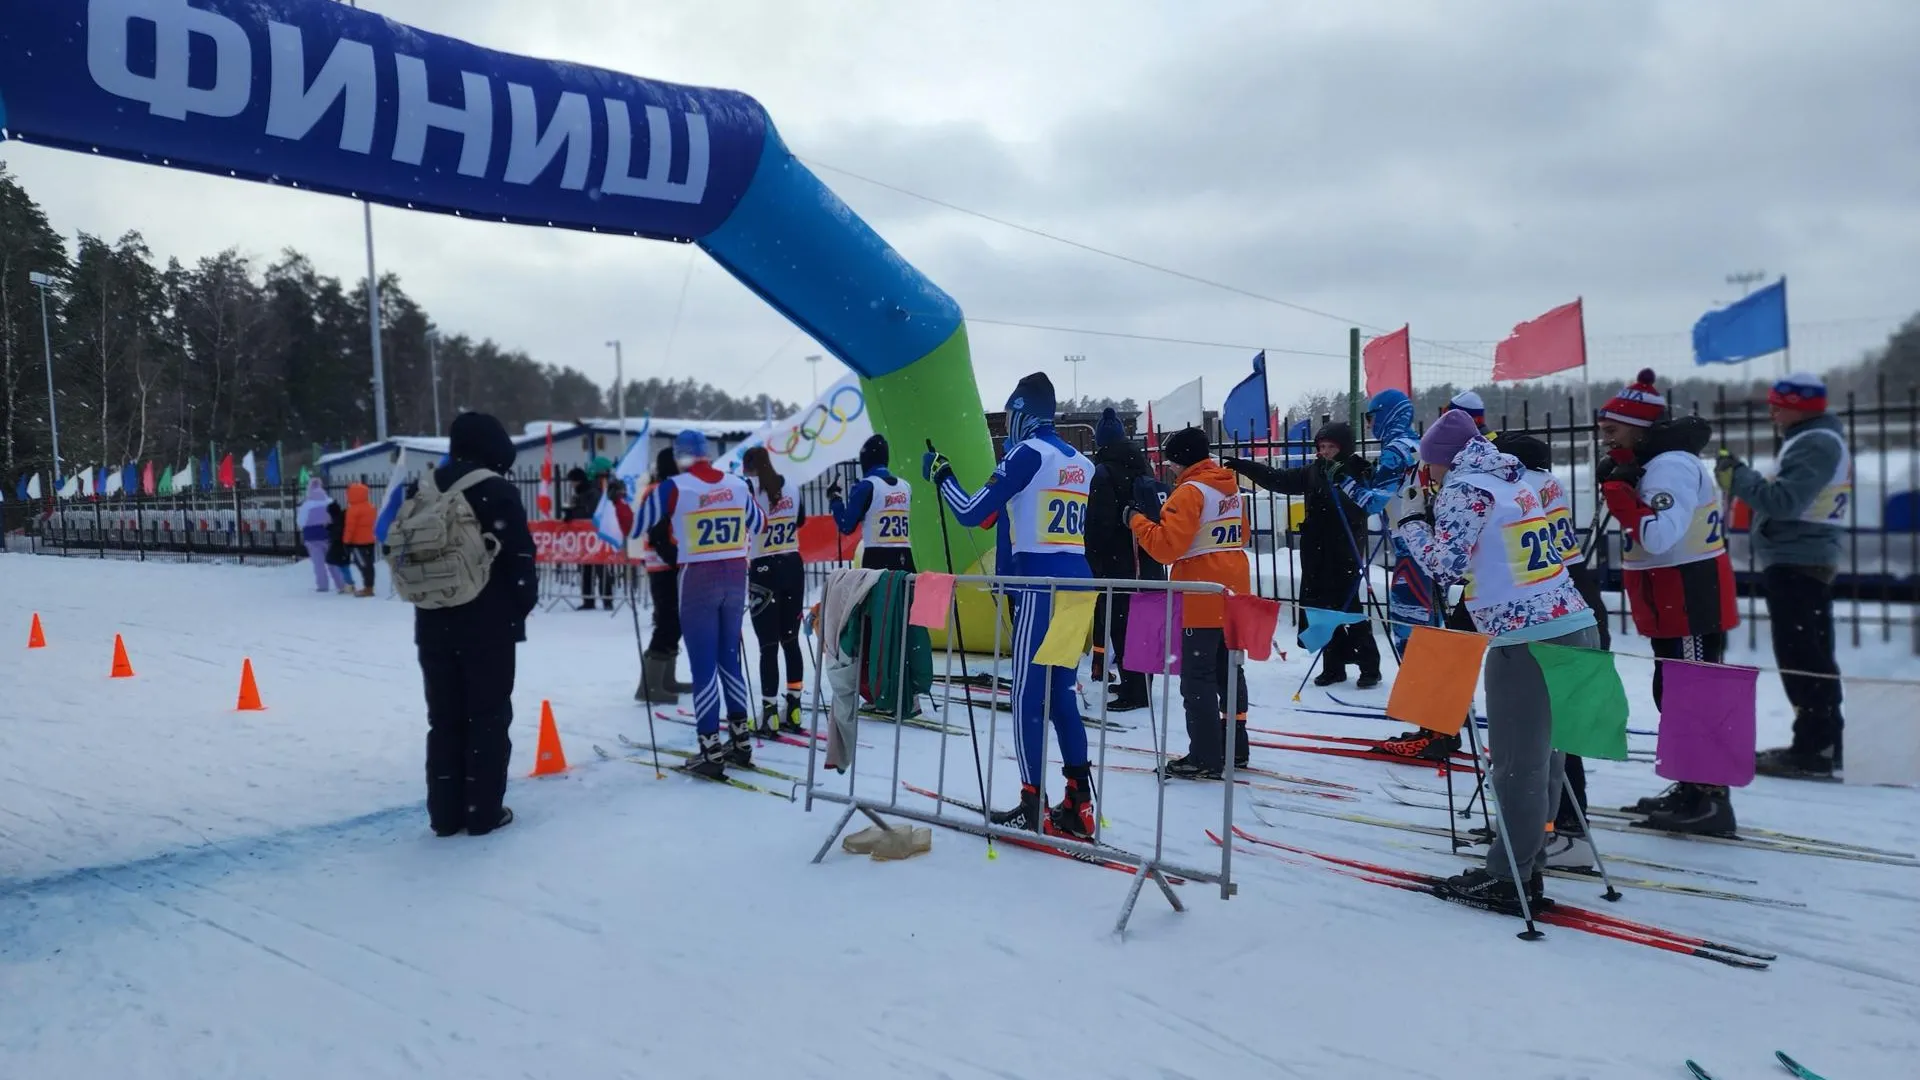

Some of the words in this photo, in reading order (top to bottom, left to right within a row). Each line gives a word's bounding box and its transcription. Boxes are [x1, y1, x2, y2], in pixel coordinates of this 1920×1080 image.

[87, 0, 711, 204] ФИНИШ
[697, 516, 741, 546] 257
[763, 521, 798, 548] 232
[879, 515, 909, 537] 235
[1211, 524, 1242, 545] 24
[532, 531, 617, 554] ЕРНОГО
[1520, 527, 1563, 571] 23
[1003, 813, 1027, 829] OSSI
